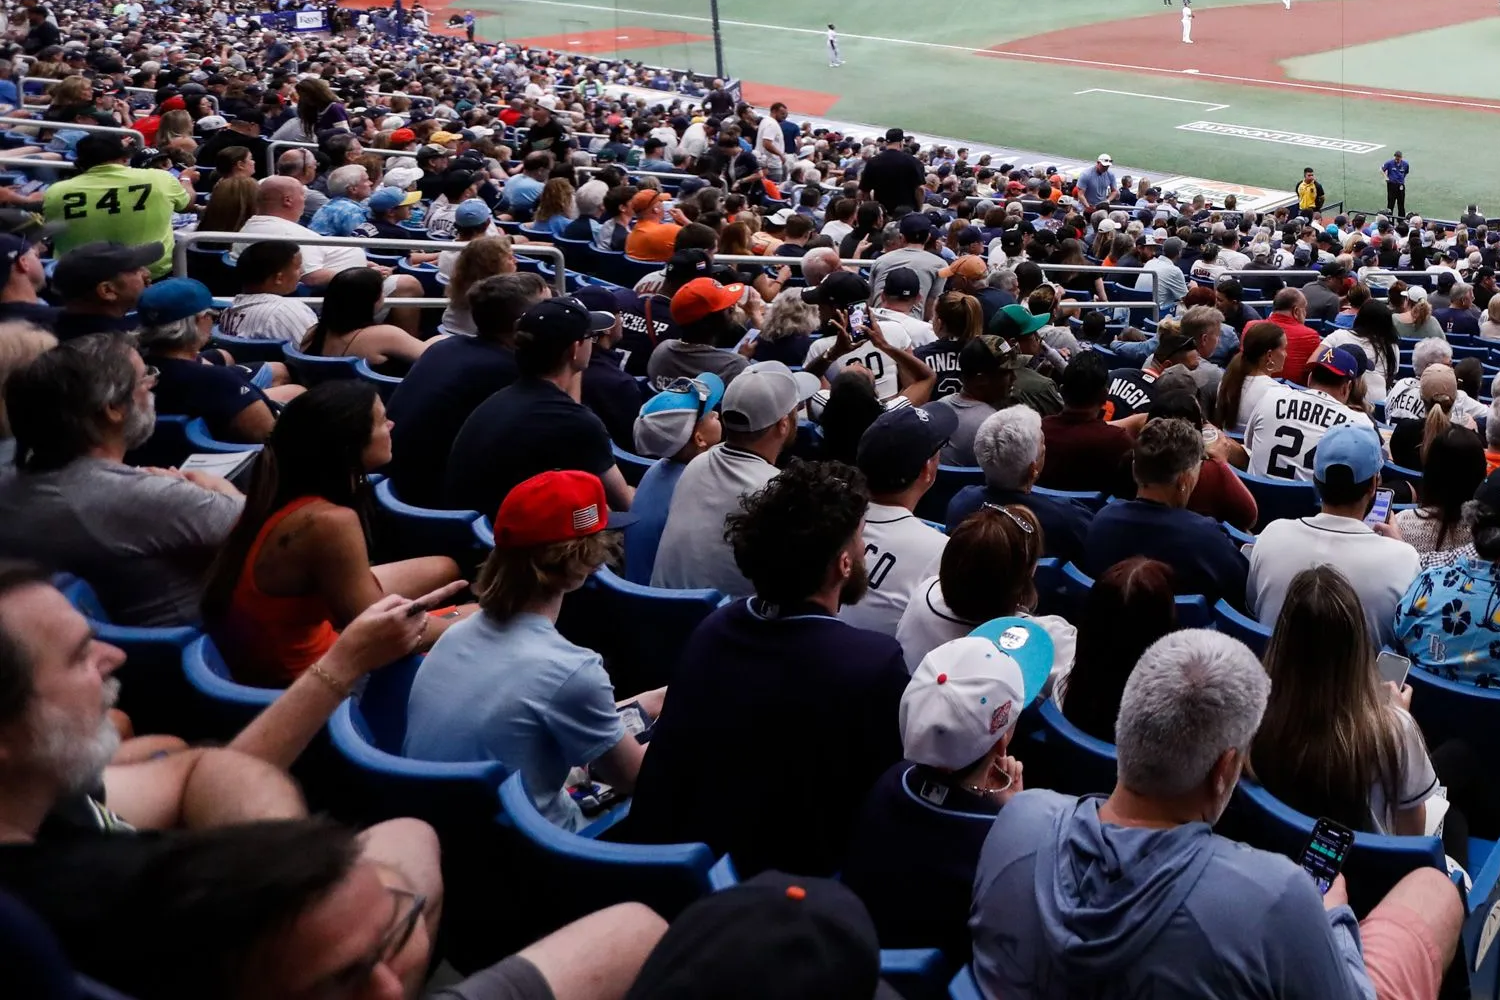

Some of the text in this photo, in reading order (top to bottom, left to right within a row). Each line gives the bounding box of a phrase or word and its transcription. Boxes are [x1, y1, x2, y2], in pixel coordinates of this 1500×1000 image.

[1190, 121, 1370, 151] BAYFRONT HEALTH
[63, 183, 152, 220] 247
[1274, 255, 1284, 268] 8
[1109, 377, 1150, 410] MIGGY
[1276, 399, 1355, 428] CABRER
[1427, 633, 1446, 663] TB
